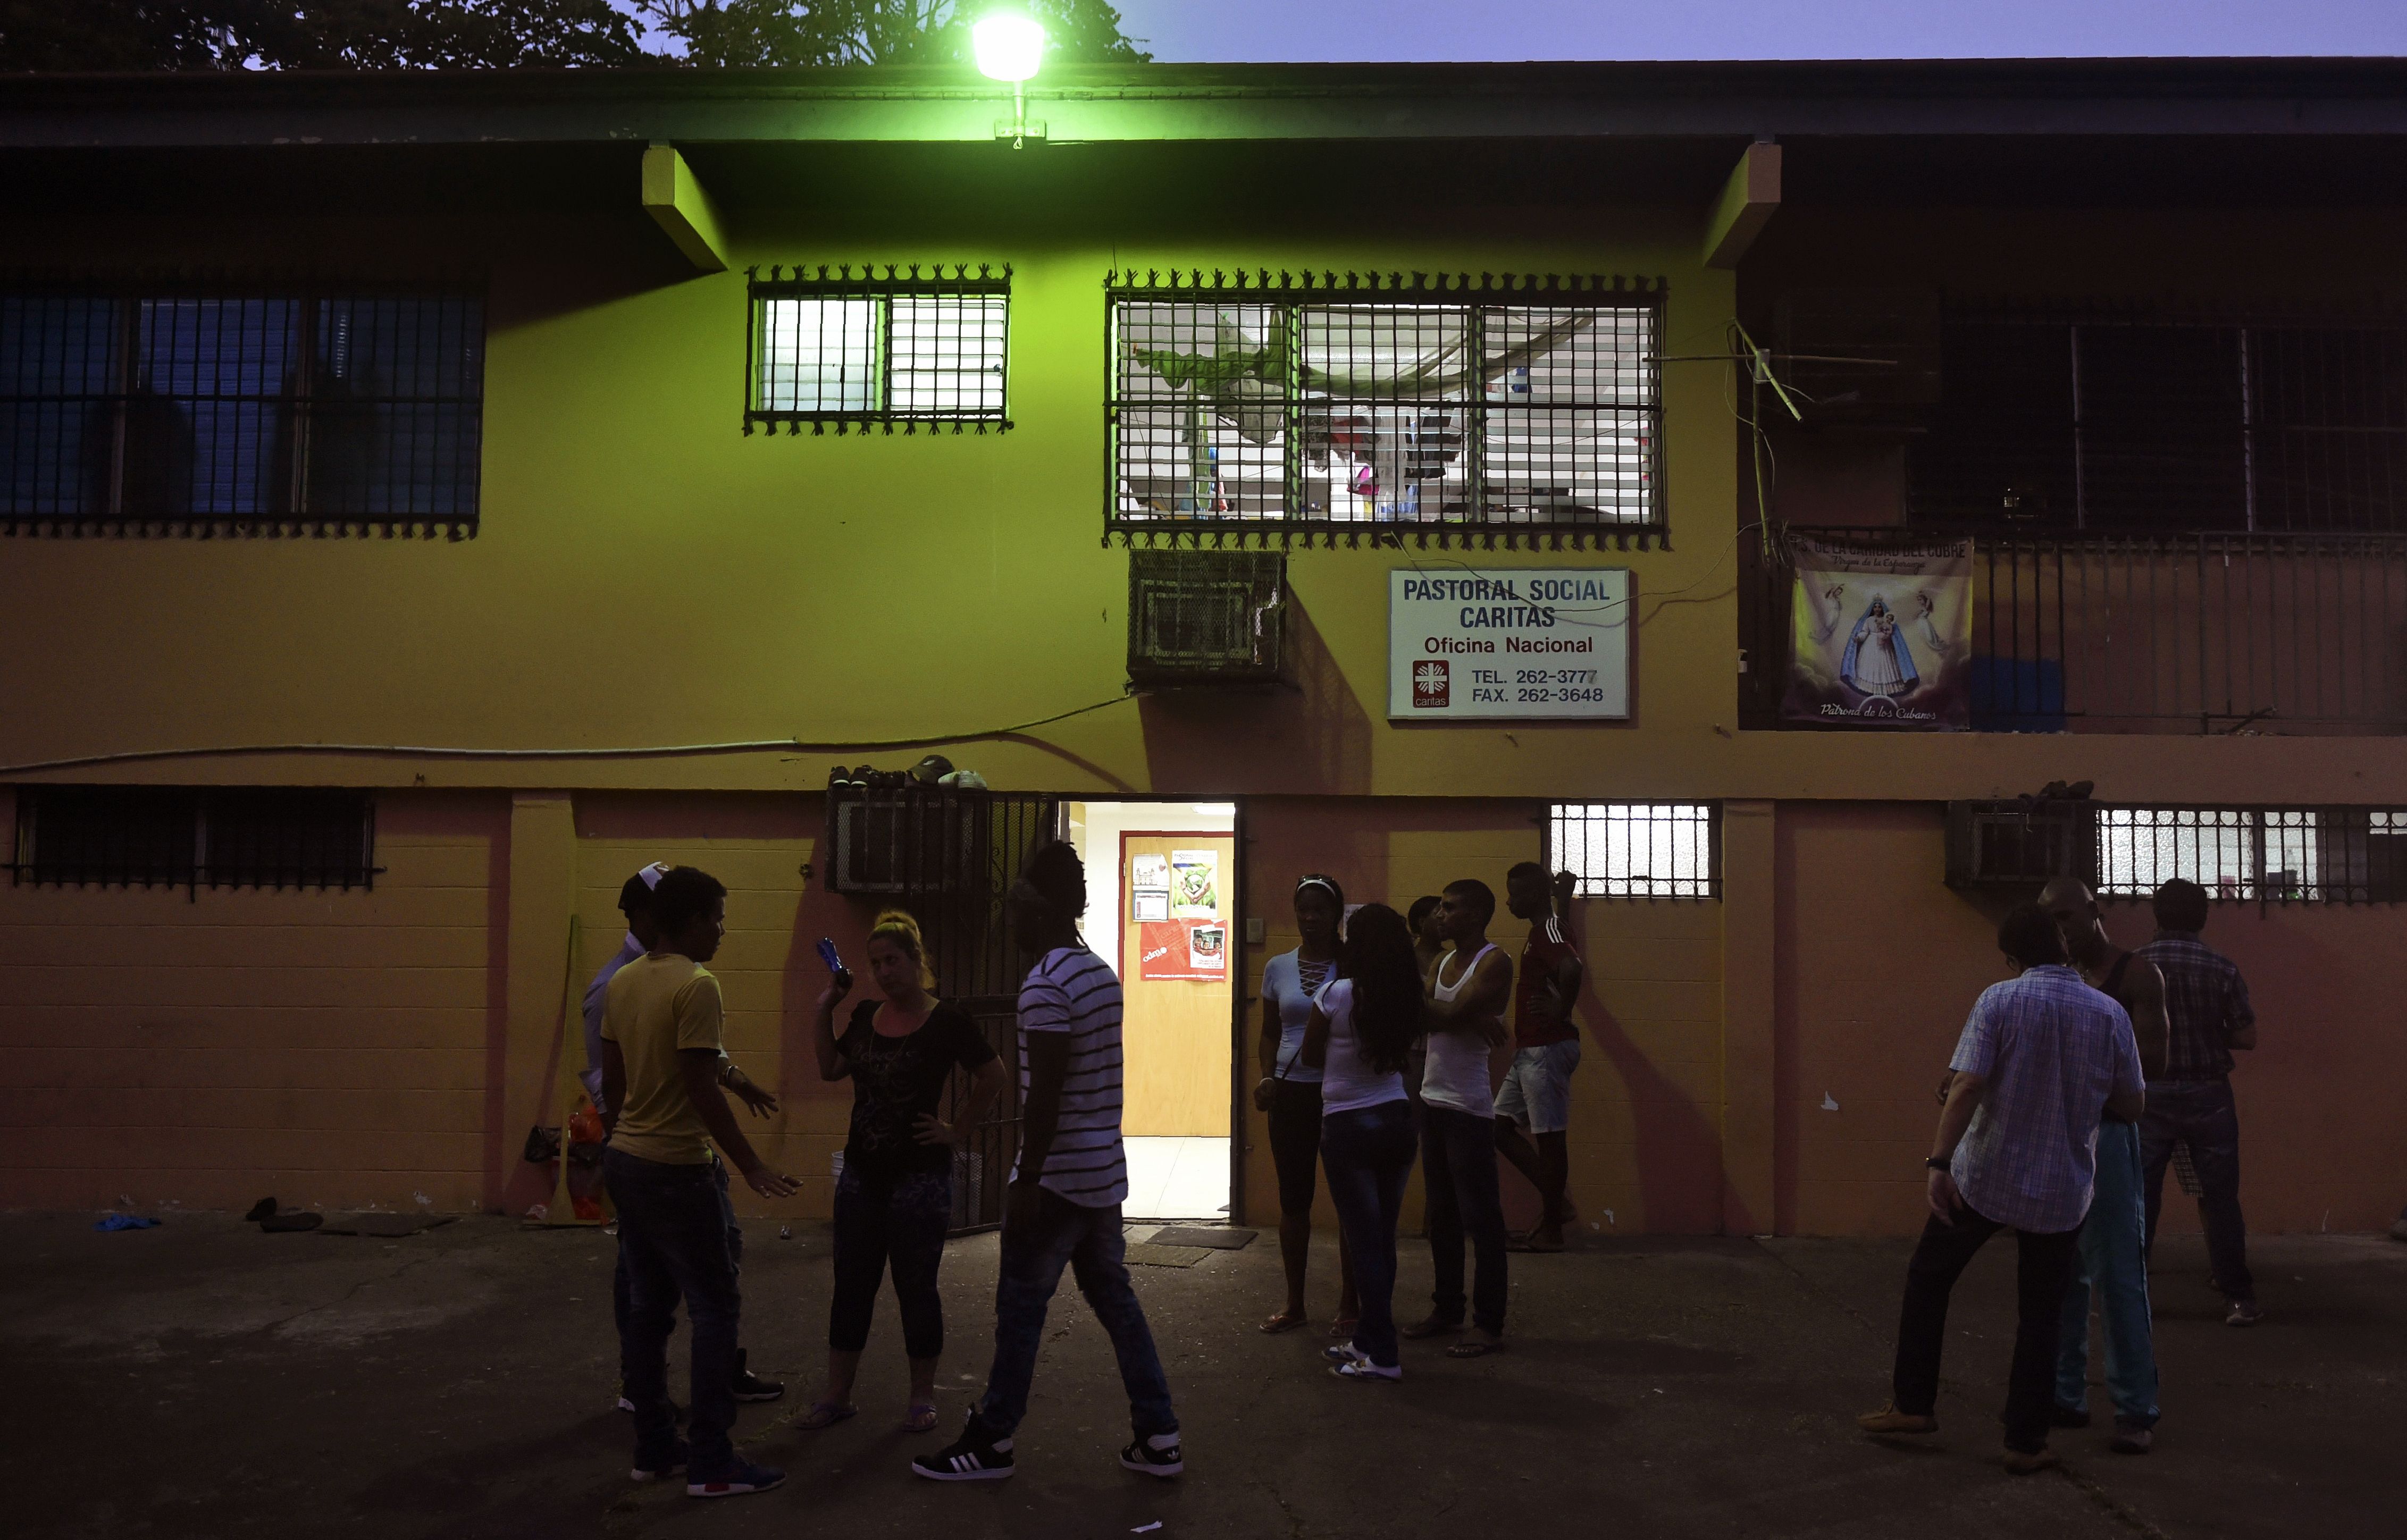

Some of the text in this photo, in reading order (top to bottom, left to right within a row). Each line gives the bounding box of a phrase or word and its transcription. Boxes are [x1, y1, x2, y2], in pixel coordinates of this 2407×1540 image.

[1815, 540, 1829, 553] DE
[1832, 542, 1847, 554] LA
[1903, 543, 1925, 558] DEL
[1927, 543, 1966, 558] COBRE
[1831, 556, 1926, 575] Virgen de la Esperanza
[1404, 579, 1610, 601] PASTORAL SOCIAL
[1460, 607, 1556, 628] CARITAS
[1424, 636, 1593, 653] Oficina Nacional
[1472, 669, 1597, 685] TEL. 262-3777
[1415, 697, 1446, 706] caritas
[1472, 688, 1604, 702] FAX. 262-3648
[1820, 703, 1936, 720] Patrona de los Cubanos
